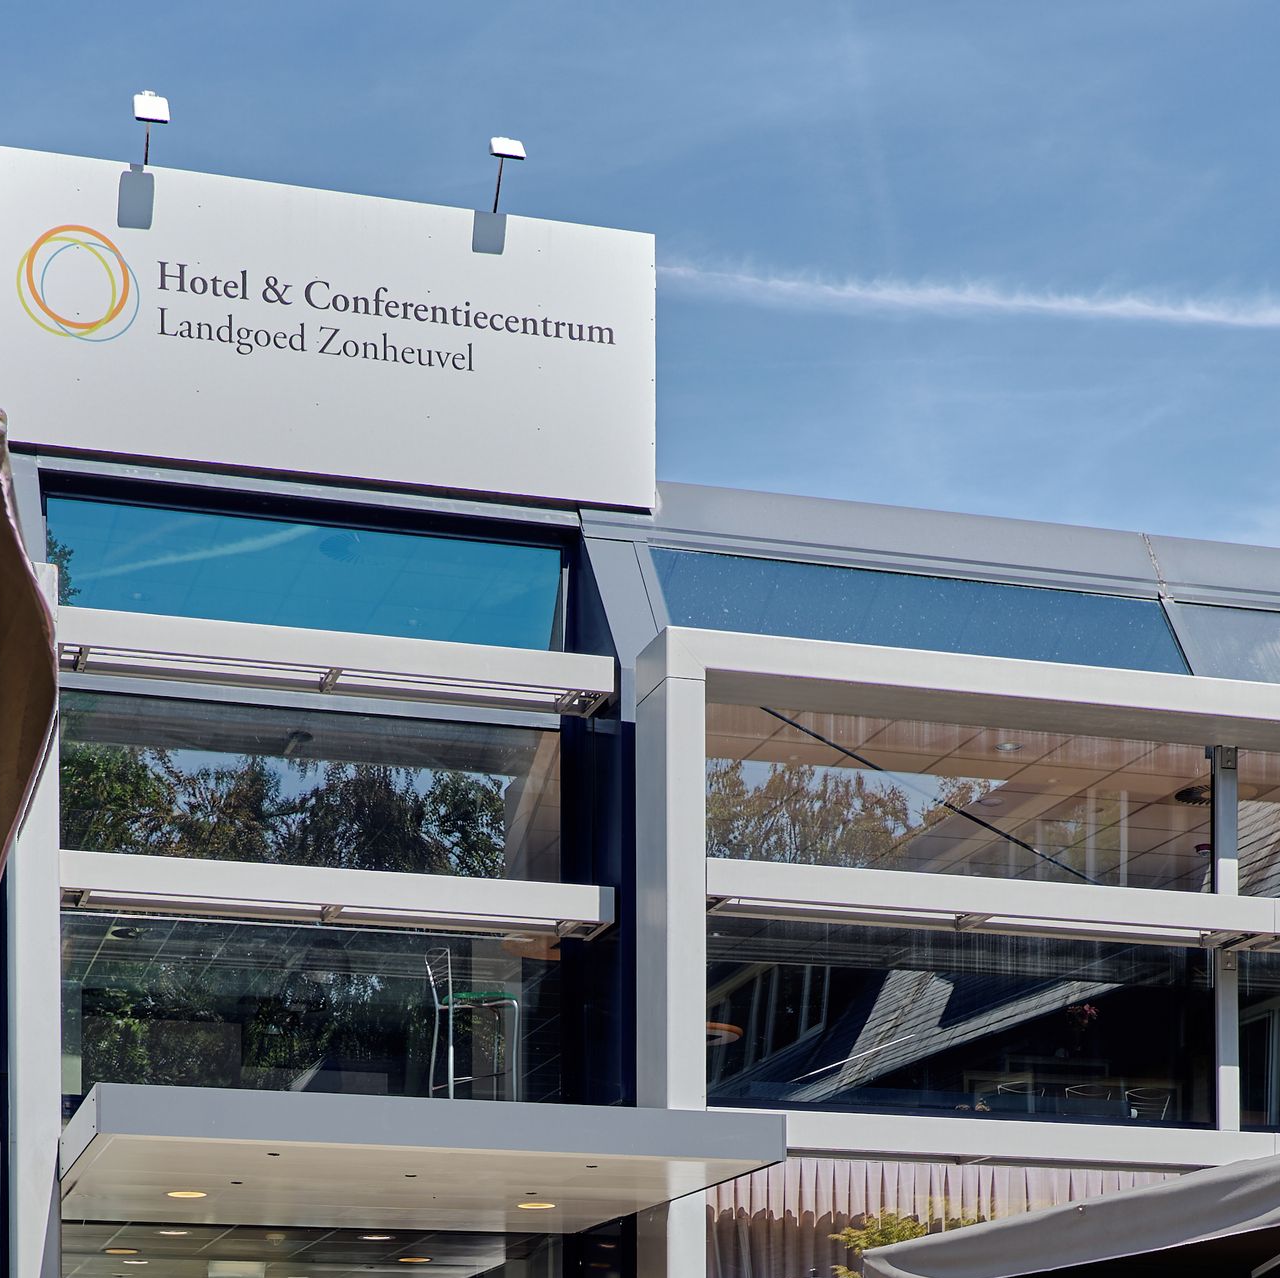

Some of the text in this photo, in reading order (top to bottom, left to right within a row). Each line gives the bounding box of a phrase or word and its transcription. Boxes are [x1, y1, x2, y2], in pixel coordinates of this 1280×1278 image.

[157, 260, 617, 345] Hotel & Conferentiecentrum
[157, 306, 476, 372] Landgoed Zonheuvel
